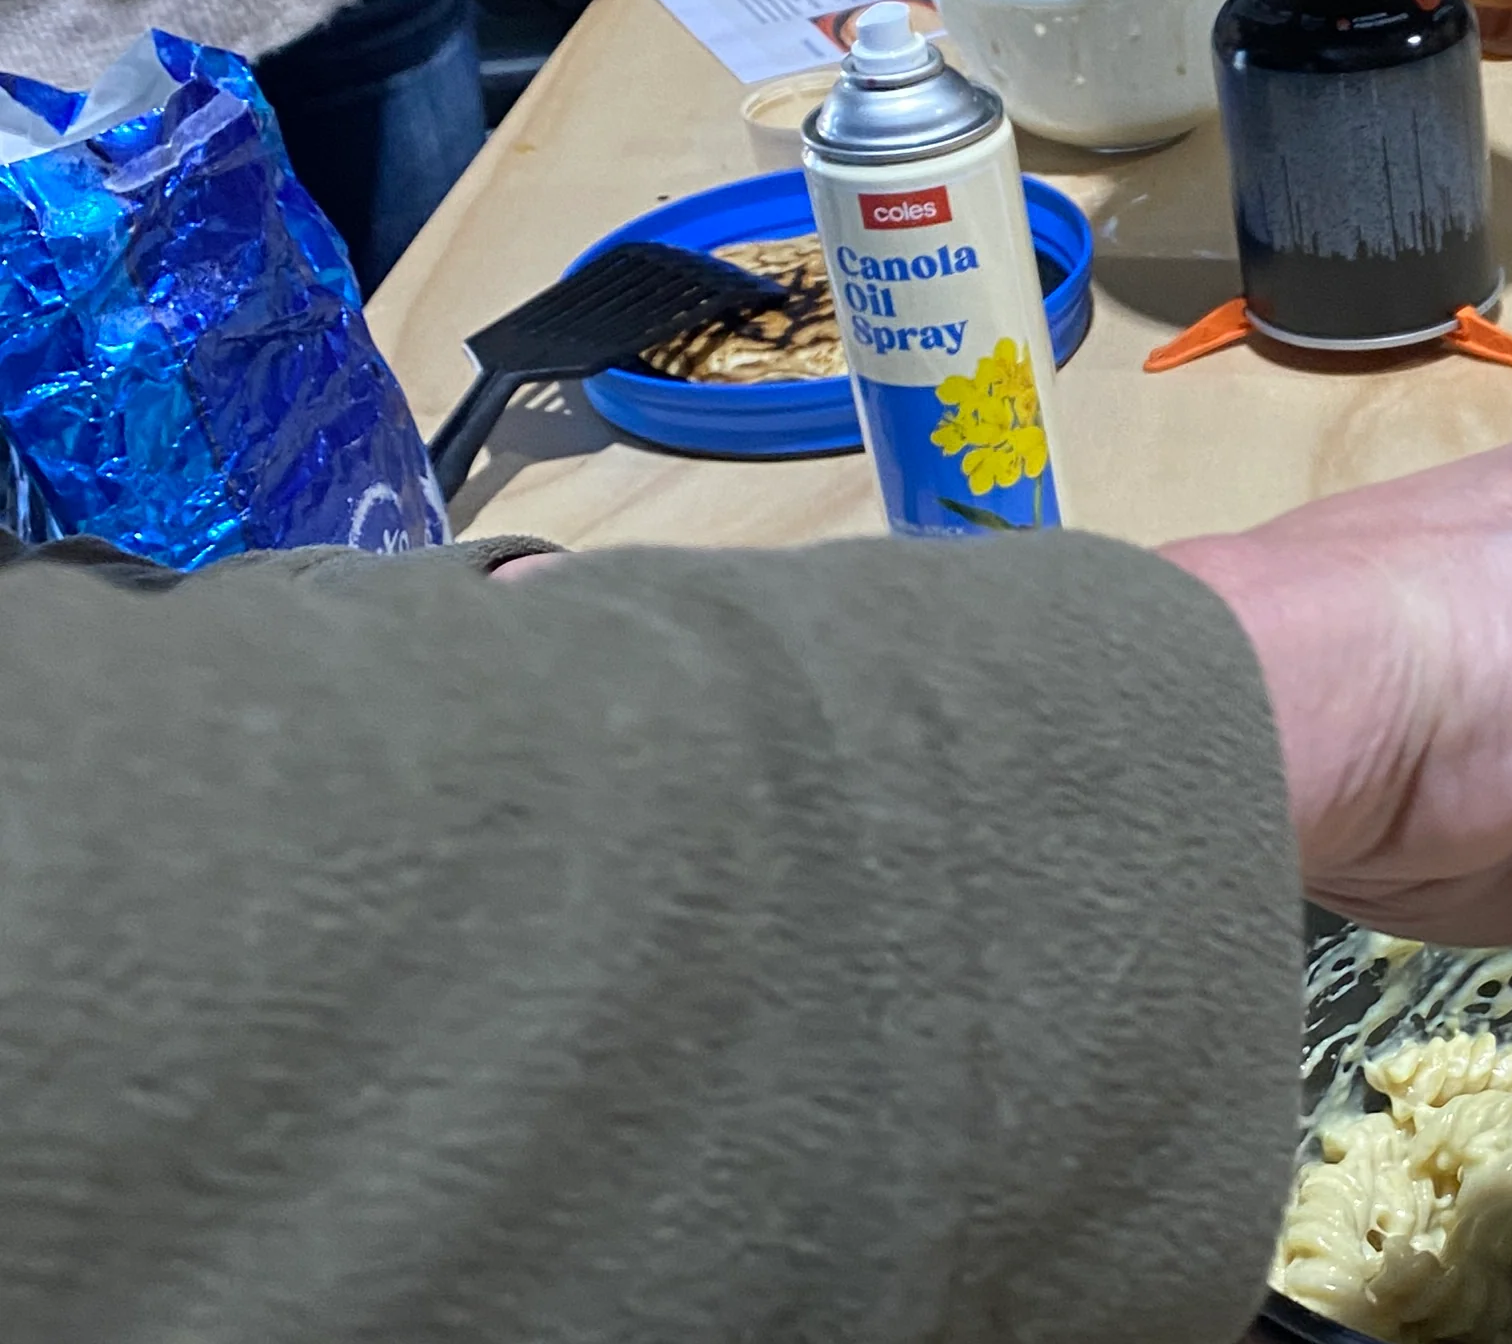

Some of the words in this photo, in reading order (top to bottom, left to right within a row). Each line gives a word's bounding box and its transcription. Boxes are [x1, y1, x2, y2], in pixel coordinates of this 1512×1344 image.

[873, 201, 938, 223] coles
[837, 244, 980, 282] Canola
[844, 281, 897, 318] Oil
[851, 314, 969, 355] Spray
